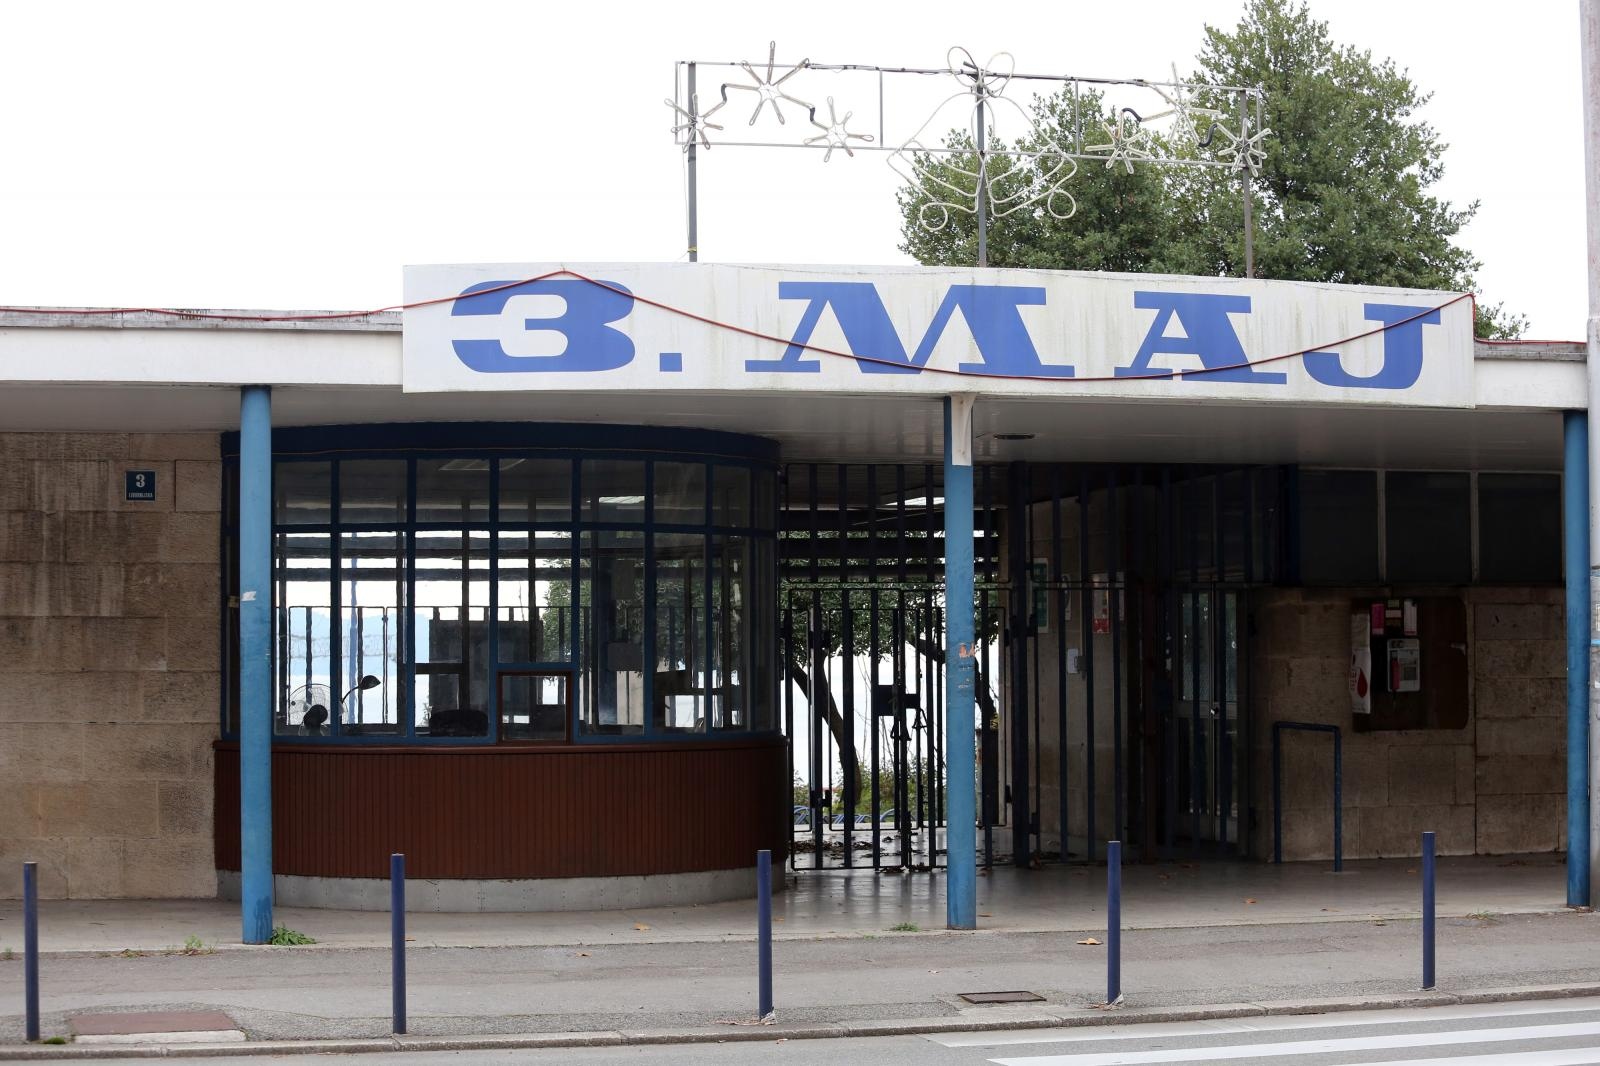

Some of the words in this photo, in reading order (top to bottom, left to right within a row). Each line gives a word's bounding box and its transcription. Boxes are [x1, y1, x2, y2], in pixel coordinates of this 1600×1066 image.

[451, 280, 682, 373] 3.
[745, 282, 1441, 389] MAJ
[135, 473, 146, 488] 3
